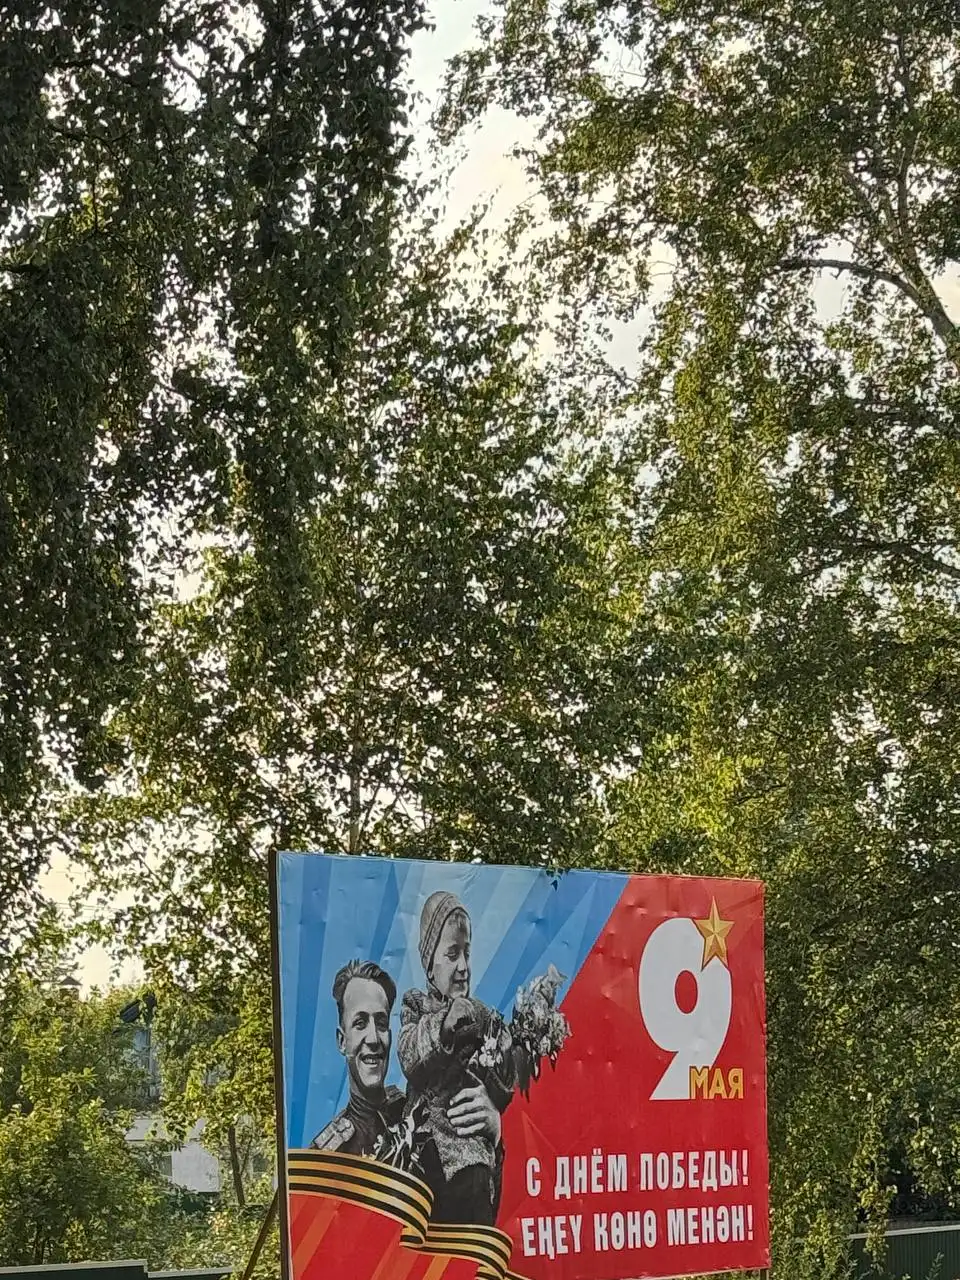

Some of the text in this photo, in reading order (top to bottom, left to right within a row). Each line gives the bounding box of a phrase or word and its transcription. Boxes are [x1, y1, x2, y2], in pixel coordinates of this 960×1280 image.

[639, 918, 732, 1101] 9
[689, 1065, 745, 1100] МАЯ
[526, 1148, 749, 1200] С ДНЁМ ПОБЕДЫ!
[593, 1209, 658, 1251] КӨНӨ
[666, 1204, 754, 1246] МЕНӘН!
